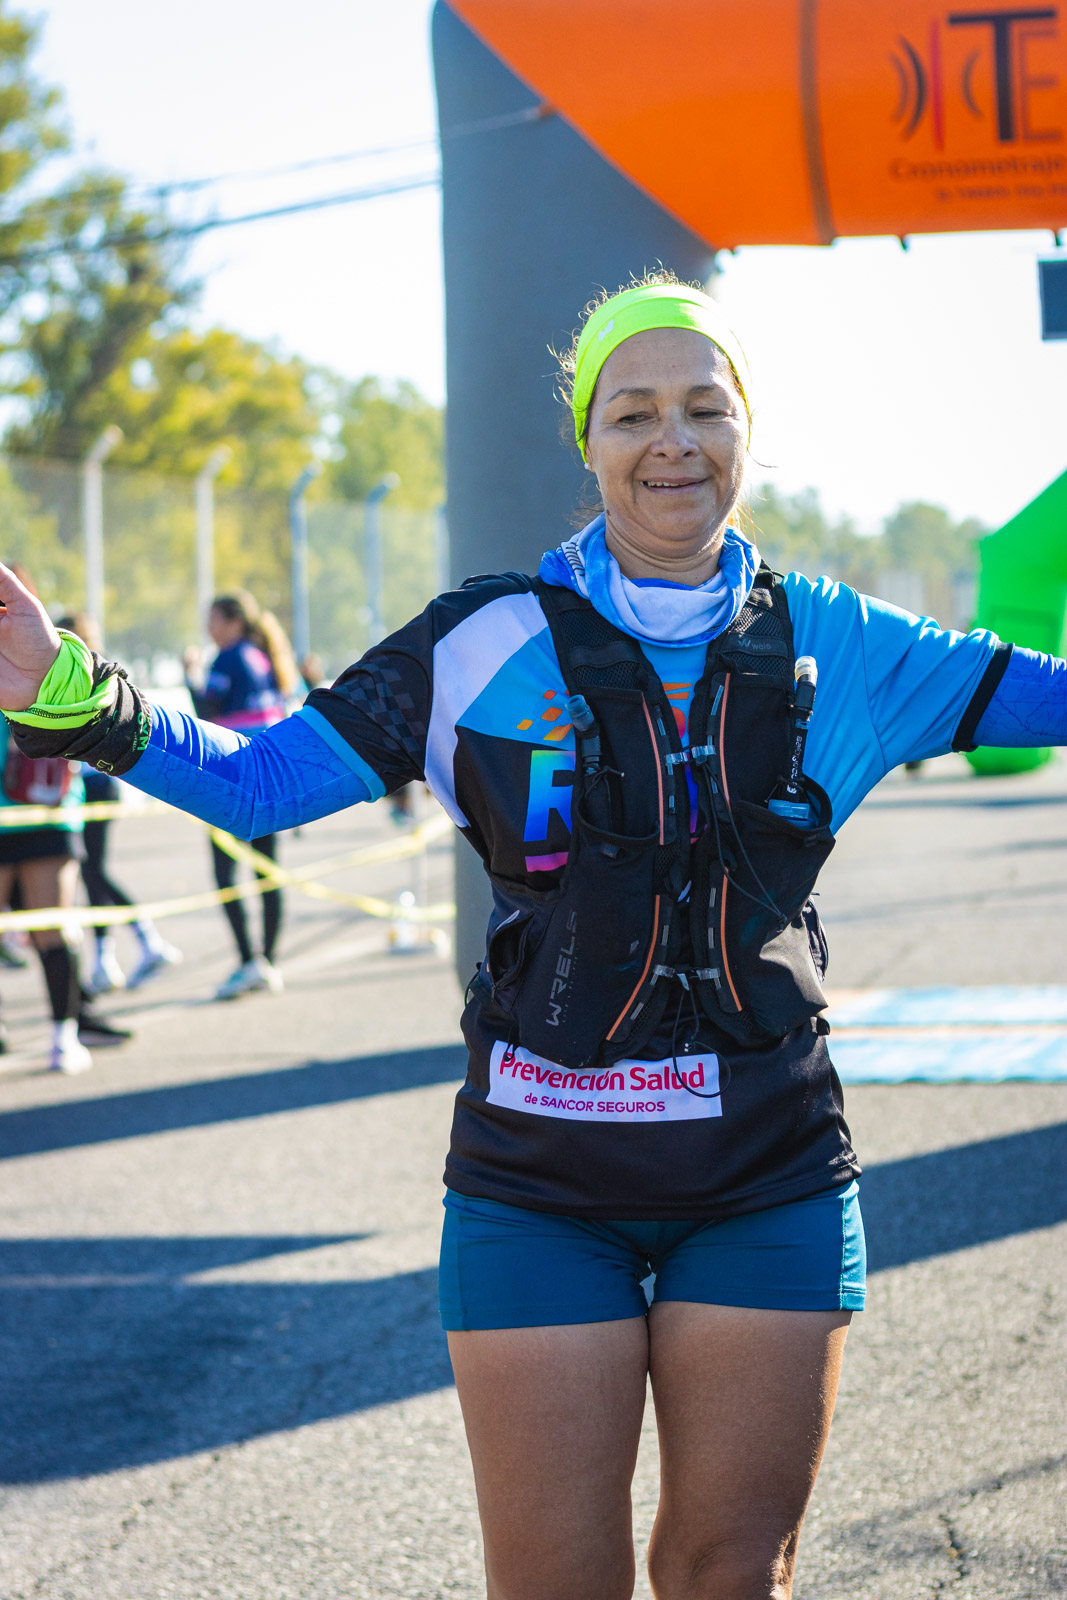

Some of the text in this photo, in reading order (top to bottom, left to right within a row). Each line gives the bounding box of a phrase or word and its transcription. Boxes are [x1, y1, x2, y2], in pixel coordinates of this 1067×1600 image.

[499, 1052, 705, 1092] Prevención Salud
[524, 1092, 666, 1113] de SANCOR SEGUROS
